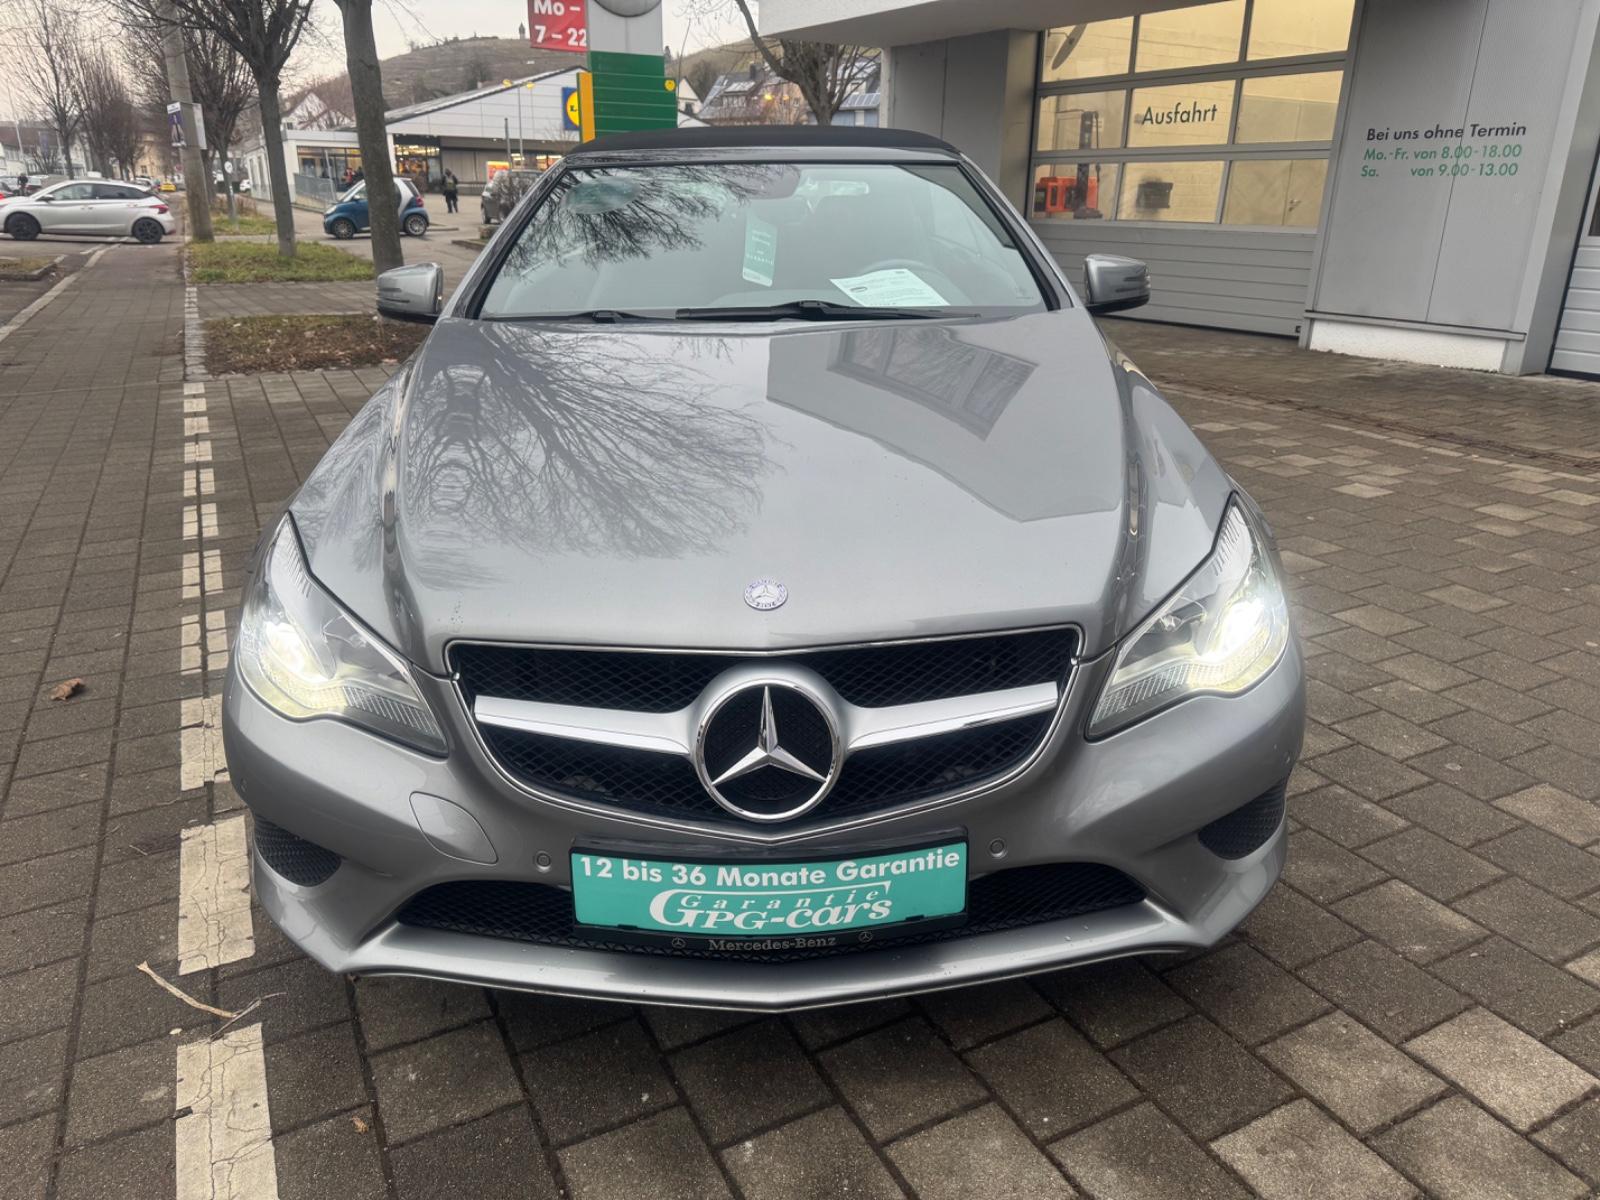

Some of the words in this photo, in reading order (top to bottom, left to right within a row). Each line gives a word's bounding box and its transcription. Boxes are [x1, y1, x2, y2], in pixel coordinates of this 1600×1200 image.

[533, 0, 565, 16] Mo
[535, 25, 546, 43] 7
[567, 27, 587, 47] 22
[1142, 101, 1217, 125] Ausfahrt
[1367, 127, 1390, 141] Bei
[1393, 130, 1419, 140] uns
[1424, 124, 1464, 139] ohne
[1470, 122, 1527, 137] Termin
[1414, 150, 1437, 159] von
[1361, 165, 1379, 177] Sa.
[1411, 167, 1434, 176] von
[580, 856, 613, 878] 12
[623, 859, 663, 882] bis
[672, 864, 706, 886] 36
[716, 866, 826, 887] Monate
[836, 848, 960, 882] Garantie
[680, 889, 879, 909] Garantie
[708, 937, 836, 951] Mercedes-Benz
